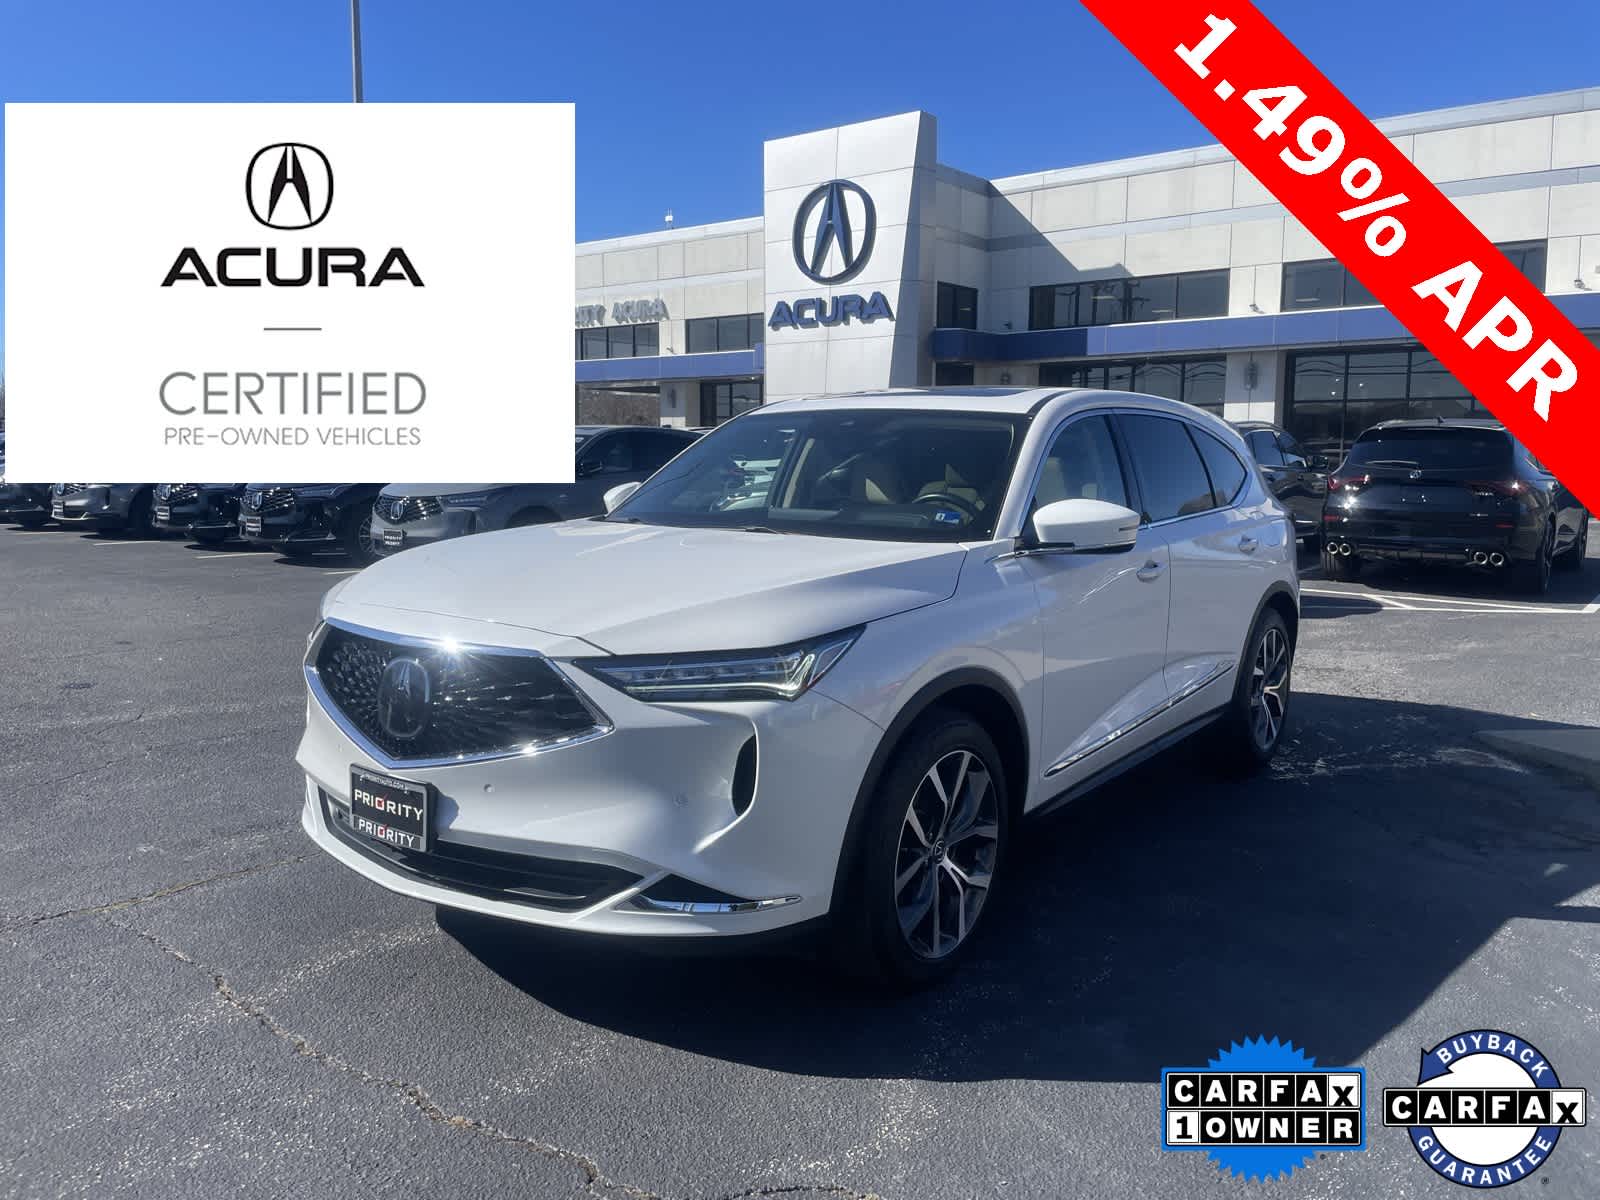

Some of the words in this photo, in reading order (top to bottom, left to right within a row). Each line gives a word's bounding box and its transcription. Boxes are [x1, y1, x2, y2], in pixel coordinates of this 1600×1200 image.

[612, 297, 670, 325] ACURA
[768, 291, 896, 331] ACURA
[354, 789, 424, 821] PRIORITY
[358, 819, 415, 848] PRIORITY
